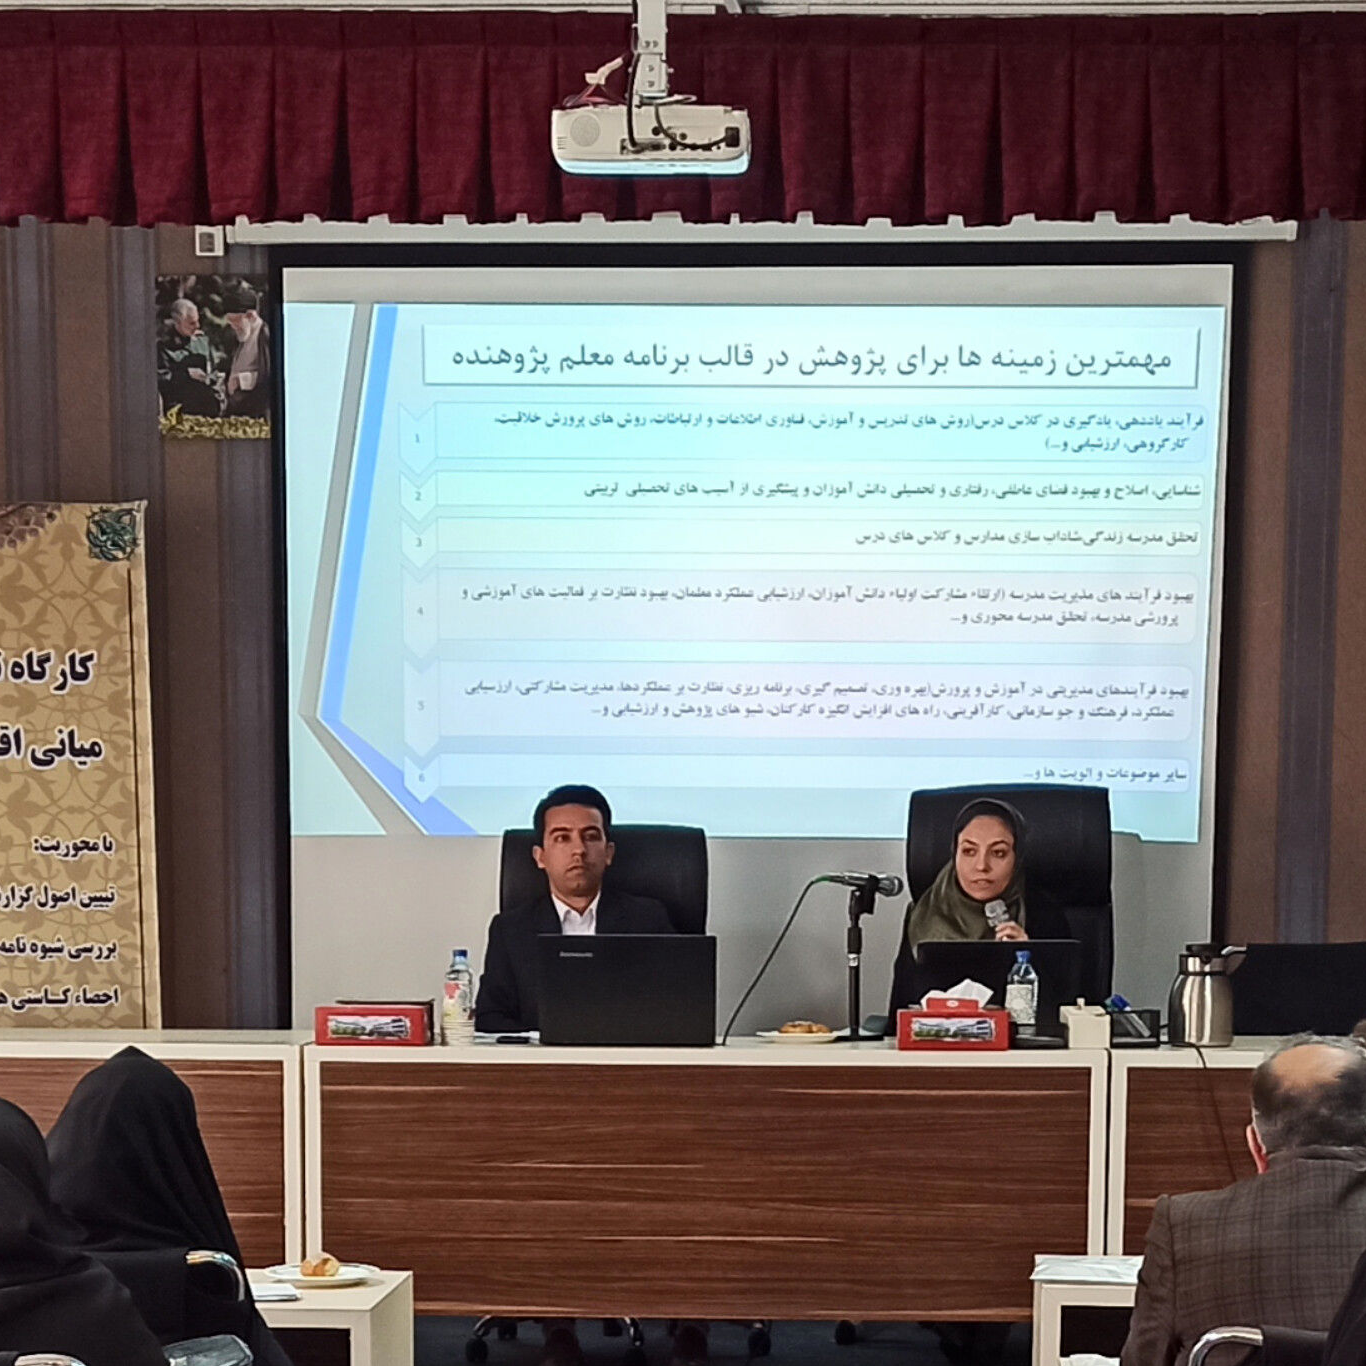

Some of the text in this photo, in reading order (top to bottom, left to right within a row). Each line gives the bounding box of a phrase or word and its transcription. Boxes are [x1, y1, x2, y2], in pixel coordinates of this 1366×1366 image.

[452, 343, 1172, 378] مهمترین زمینه ها برای پژوهش در قالب برنامه معلم پژوهنده
[1008, 414, 1041, 430] کلاس
[1046, 417, 1059, 428] در
[414, 490, 422, 502] 2
[739, 482, 749, 496] از
[10, 650, 95, 692] کارگاه
[102, 835, 113, 857] با
[36, 885, 77, 909] اصول
[79, 886, 116, 908] تبیین
[29, 936, 65, 960] شیوه
[67, 941, 117, 960] بررسی
